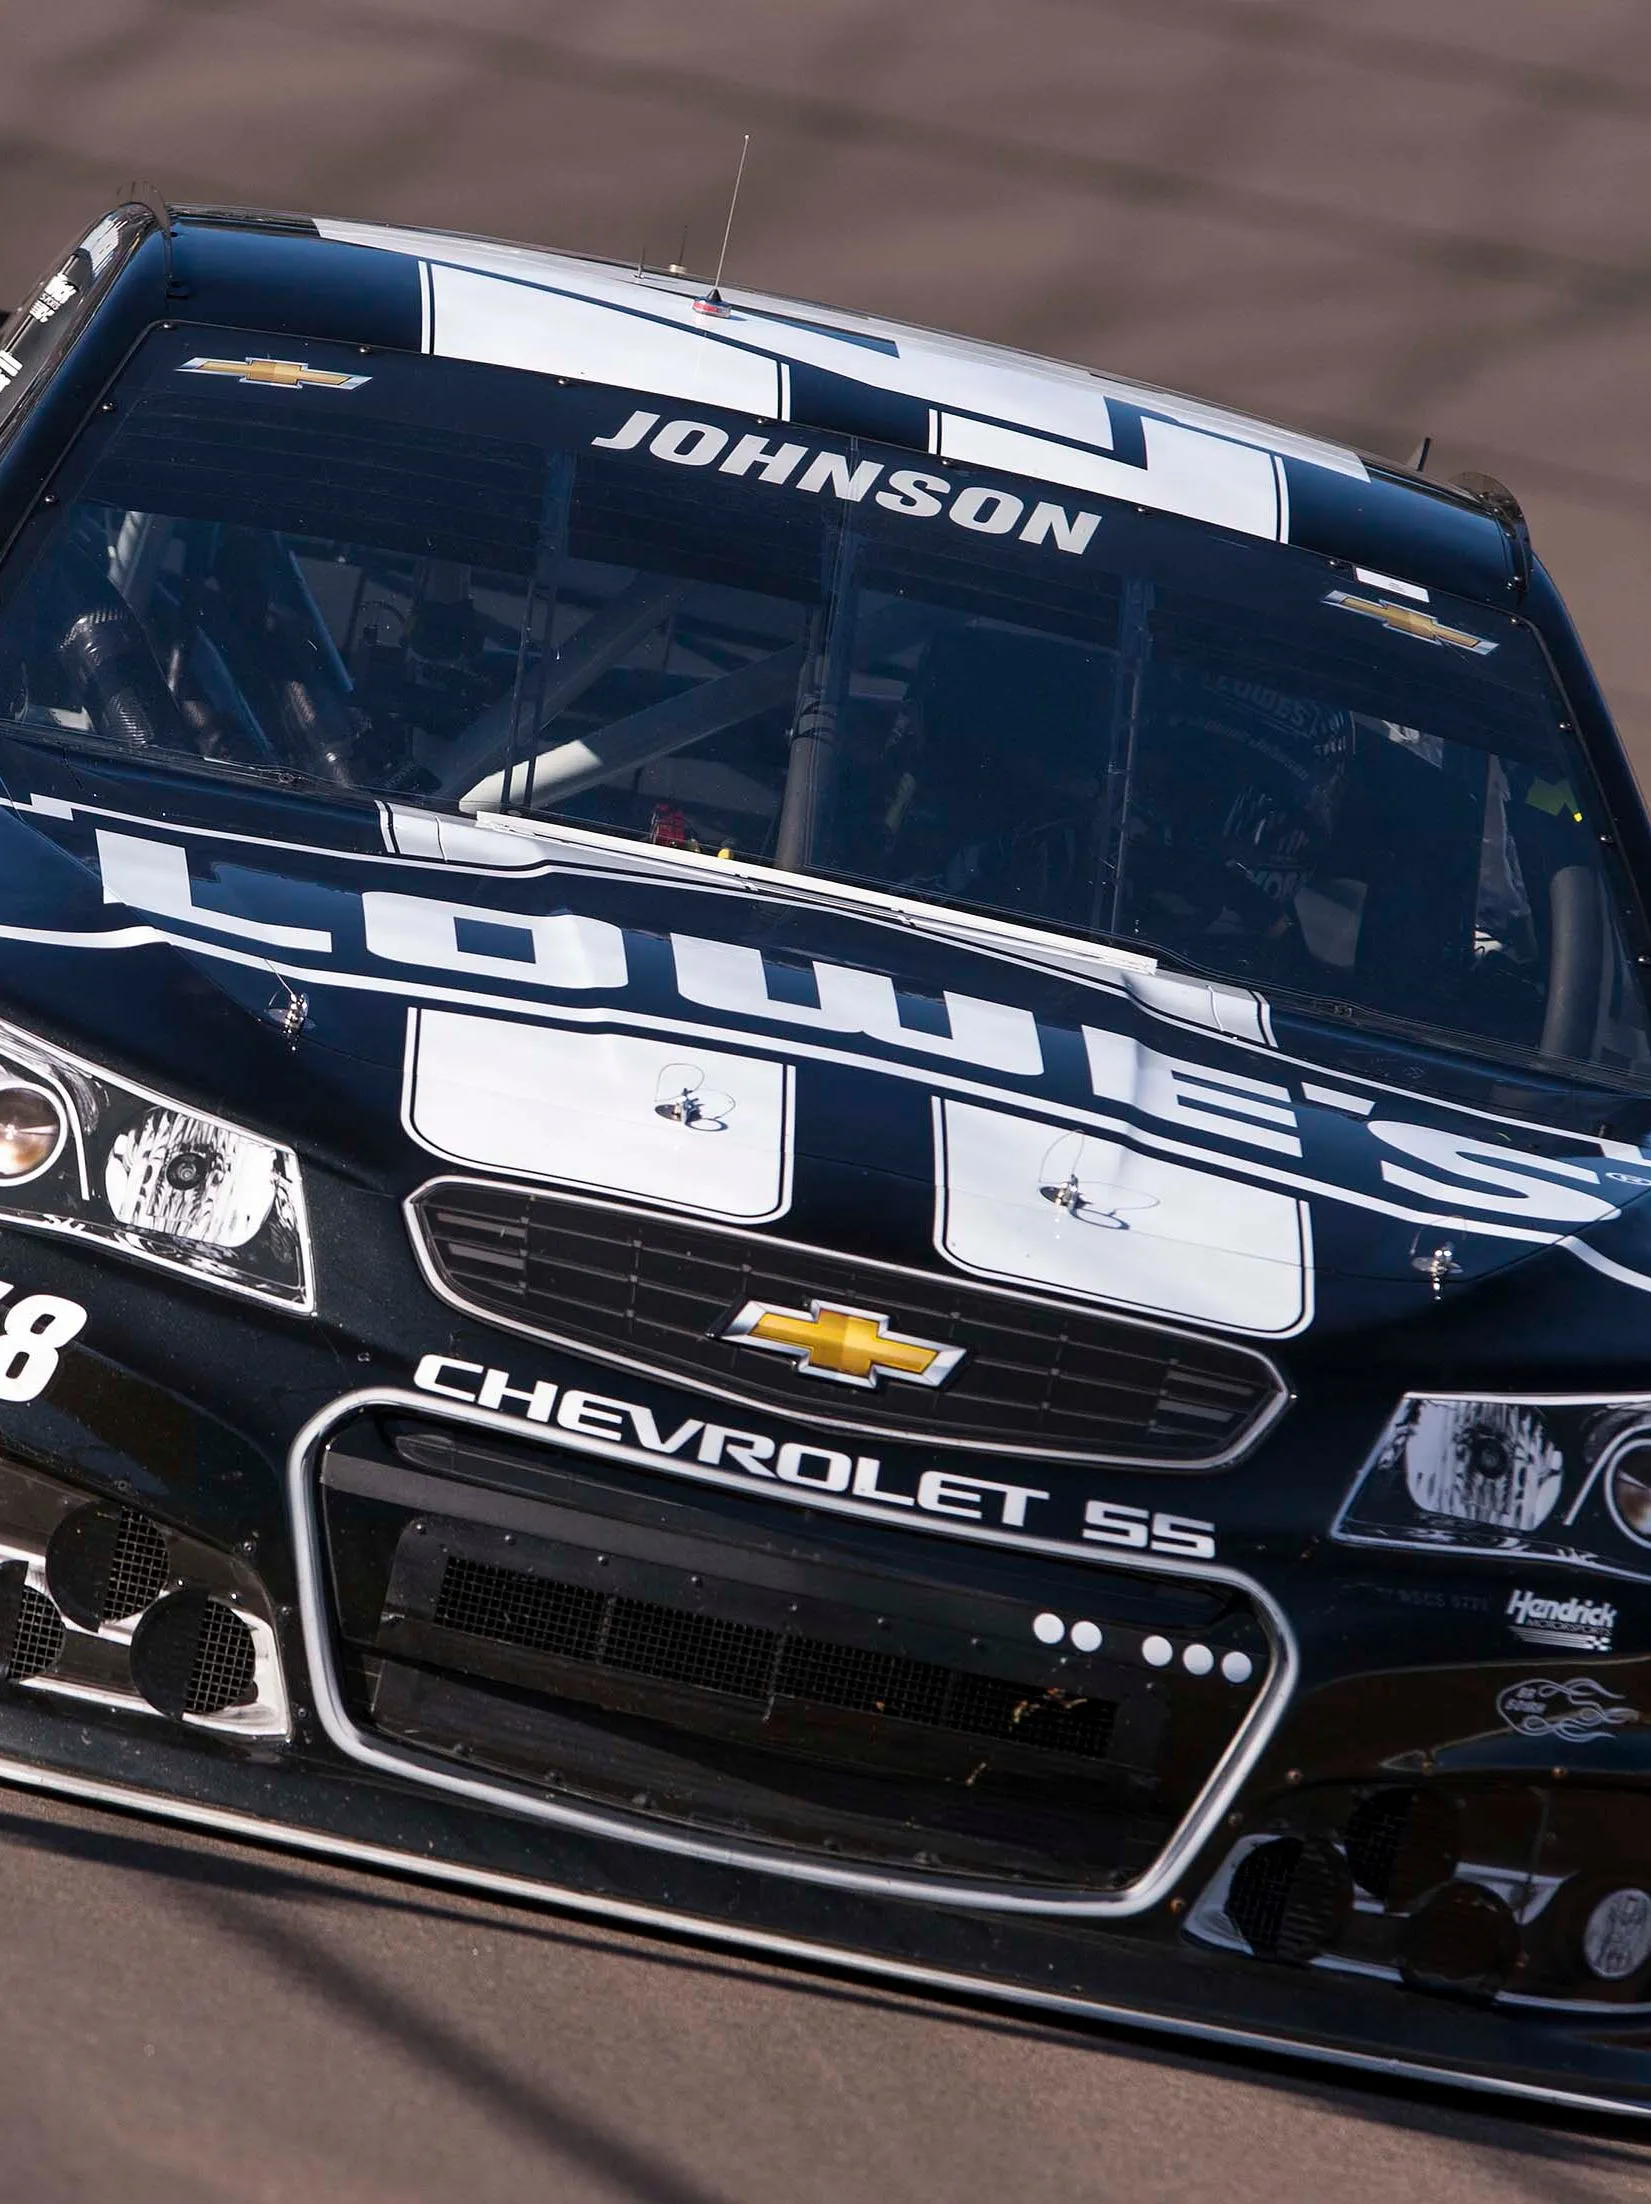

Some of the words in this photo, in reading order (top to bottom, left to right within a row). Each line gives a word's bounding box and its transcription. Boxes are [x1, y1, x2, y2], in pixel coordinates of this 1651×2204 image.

[591, 410, 1102, 555] JOHNSON
[95, 828, 1622, 1222] LOWE'S
[0, 1280, 88, 1403] 8
[413, 1353, 1050, 1528] CHEVROLET
[1082, 1499, 1216, 1559] SS
[1505, 1588, 1618, 1629] Hendrick
